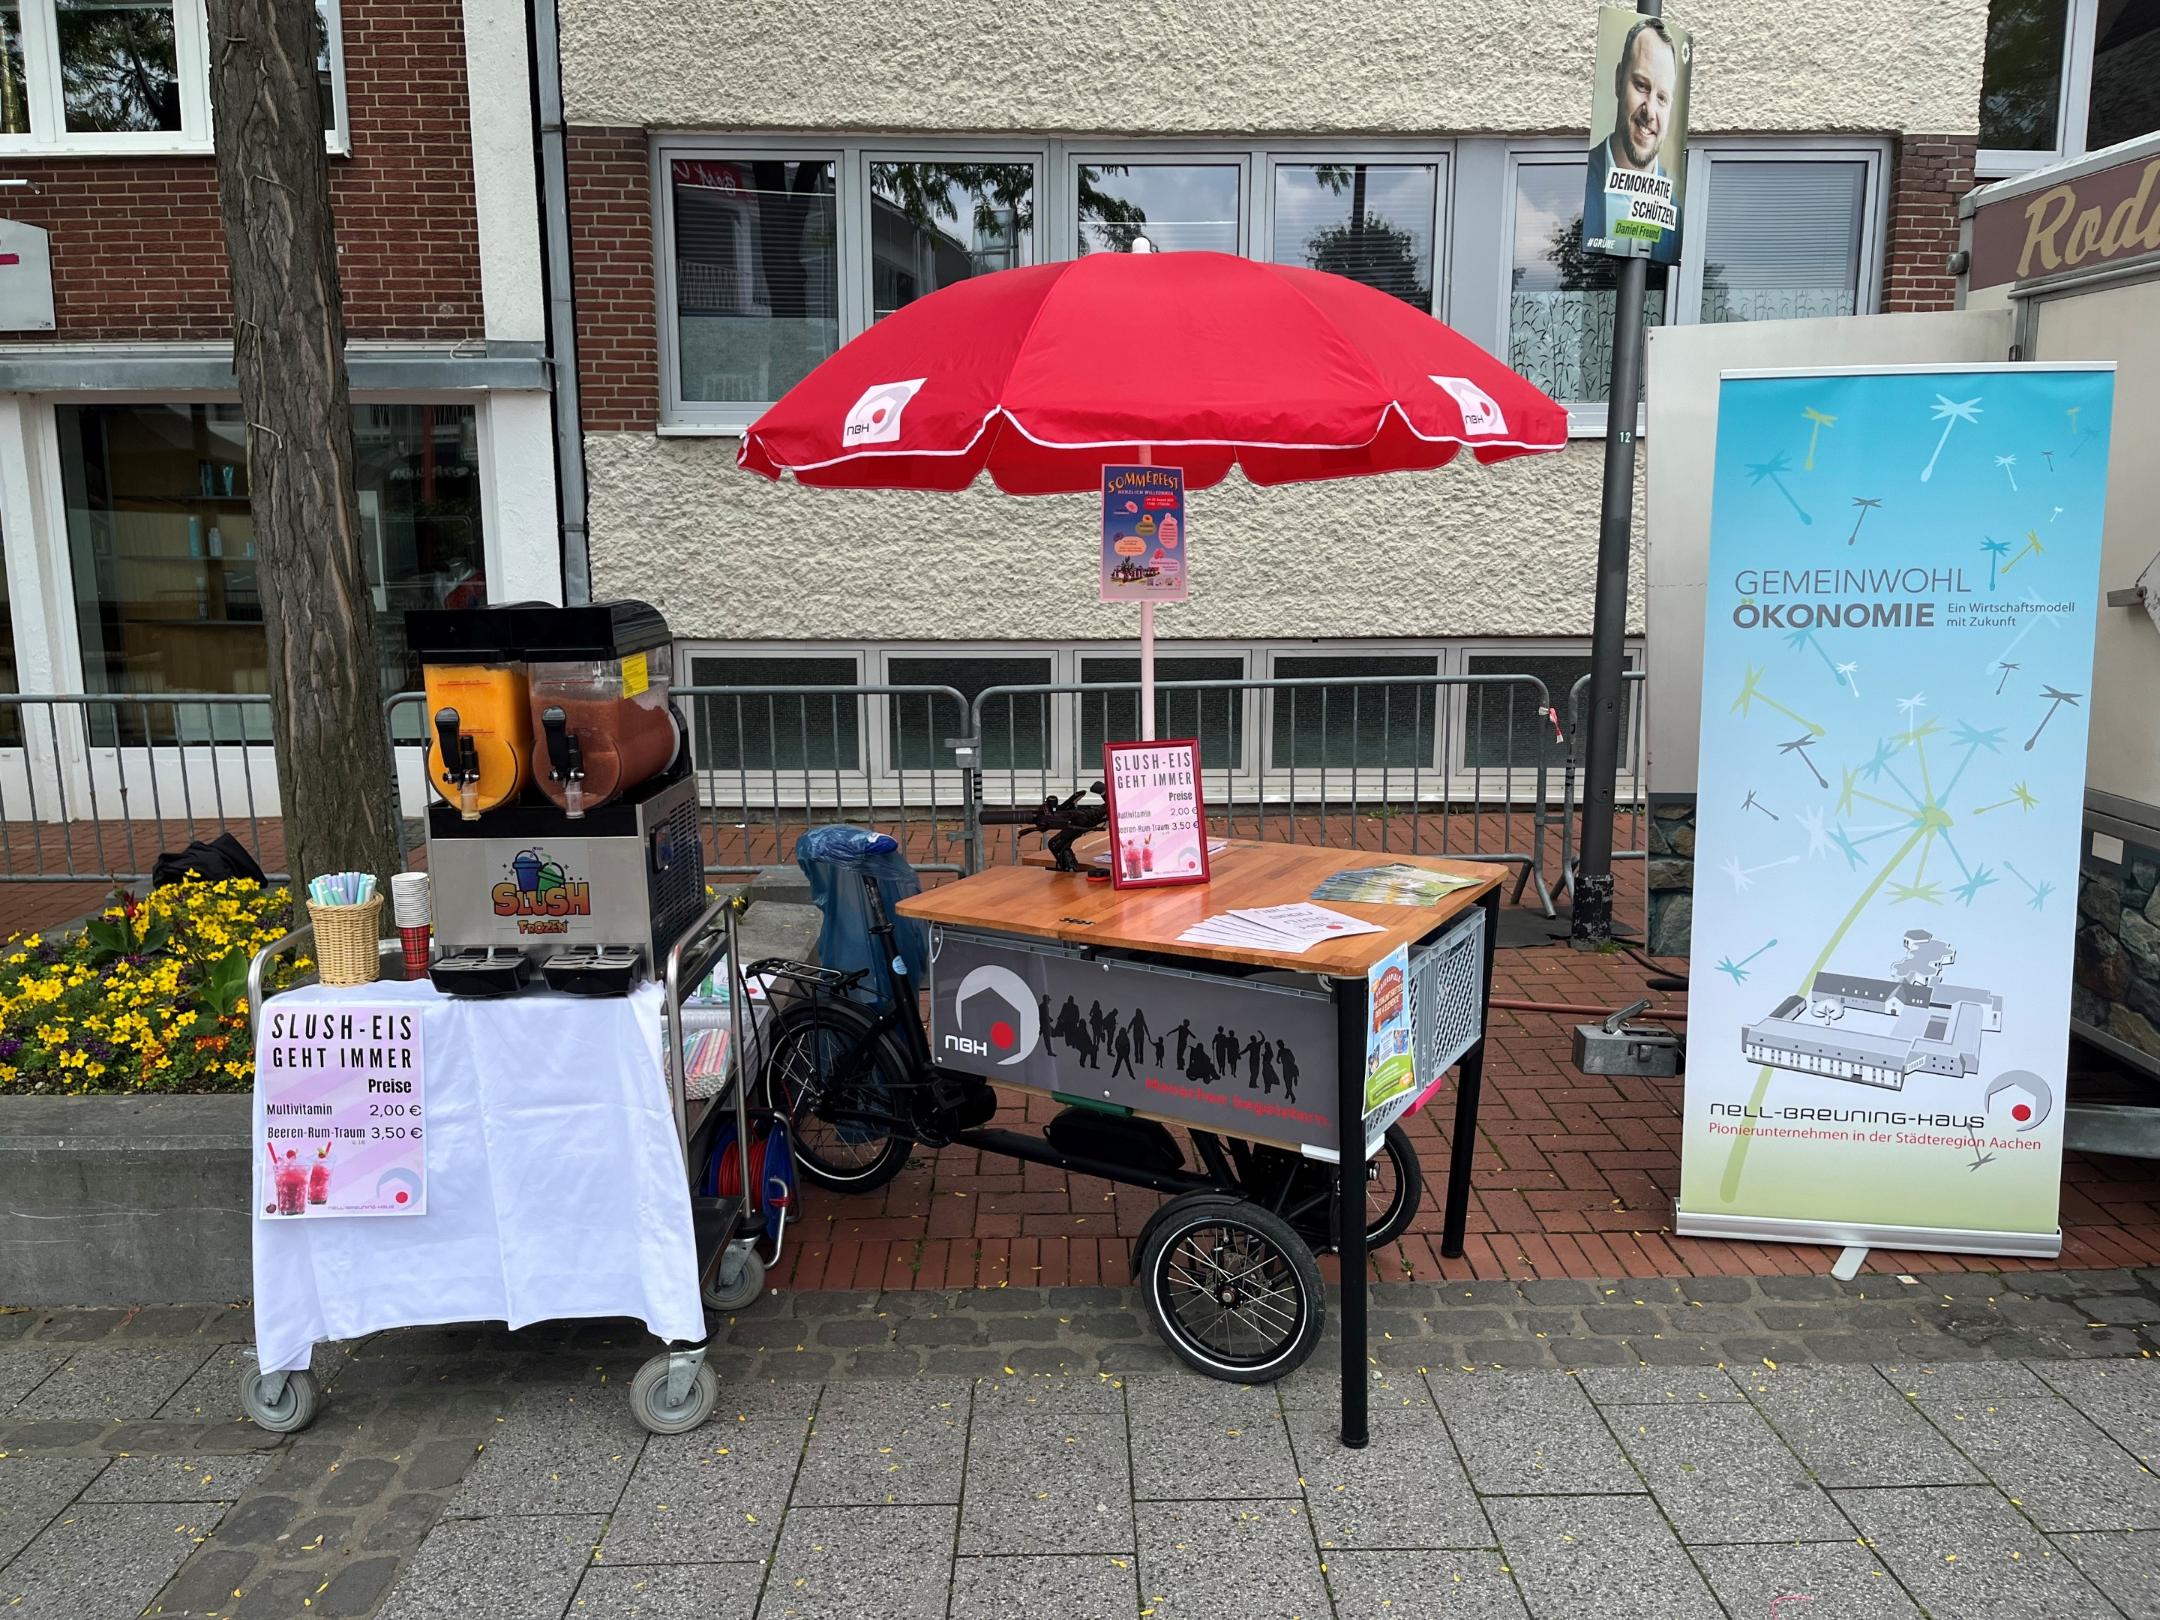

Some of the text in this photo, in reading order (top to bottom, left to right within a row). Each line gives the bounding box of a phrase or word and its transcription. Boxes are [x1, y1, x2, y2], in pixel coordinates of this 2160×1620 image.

[1609, 171, 1671, 199] DEMOKRATIE
[1631, 200, 1675, 227] SCHÜTZEN.
[1615, 222, 1660, 240] Daniel Freund
[1587, 237, 1616, 249] #GRÜNE
[1465, 414, 1484, 424] NBH
[846, 423, 870, 437] NBH
[1619, 431, 1631, 443] 12
[1108, 470, 1179, 493] SOMMERFEST
[1734, 567, 1972, 596] GEMEINWOHL
[1732, 598, 1935, 629] ÖKONOMIE
[1947, 601, 2075, 614] Ein Wirtschaftsmodell
[1946, 615, 2016, 628] mit Zukunft
[1114, 751, 1191, 772] SLUSH-EIS
[1117, 771, 1192, 789] GEHT IMMER
[1168, 791, 1193, 802] Preise
[1191, 806, 1198, 815] €
[1193, 820, 1199, 829] €
[491, 882, 592, 917] SLUSH
[517, 919, 569, 935] FROZEN
[271, 1013, 413, 1041] SLUSH-EIS
[944, 1033, 988, 1057] NBH
[272, 1047, 412, 1069] GEHT IMMER
[368, 1079, 412, 1094] Preise
[266, 1103, 422, 1119] Multivitamin 2,00 €
[267, 1126, 423, 1141] Beeren-Rum-Traum 3,50 €
[1708, 1121, 2042, 1151] Pionierunternehmen in der Städteregion Aachen
